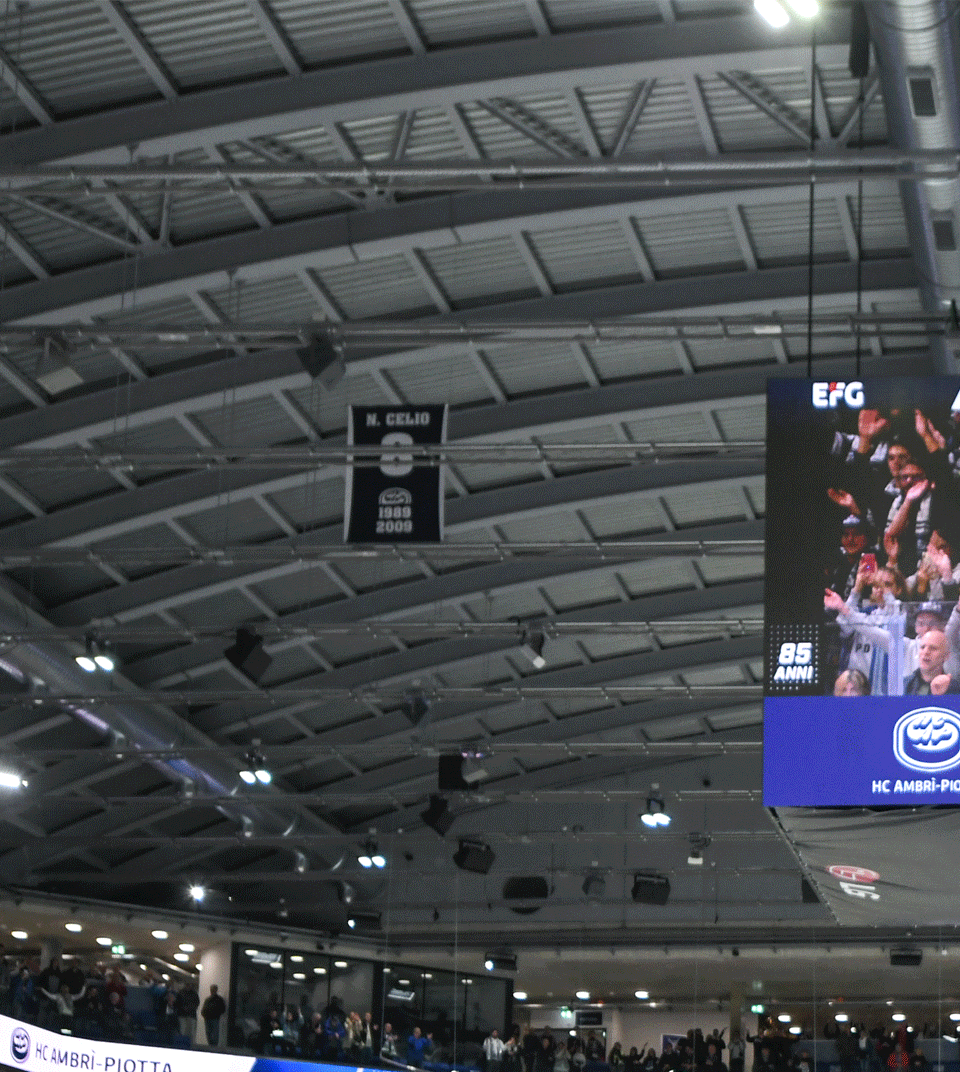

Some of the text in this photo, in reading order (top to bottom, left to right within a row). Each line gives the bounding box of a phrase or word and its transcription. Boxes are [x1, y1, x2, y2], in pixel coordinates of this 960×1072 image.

[812, 381, 864, 407] EFG
[366, 411, 430, 426] N. CELIO
[378, 506, 412, 519] 1989
[375, 519, 413, 533] 2009
[778, 642, 813, 665] 85
[773, 665, 814, 681] ANNI
[872, 780, 890, 793] HC
[35, 1042, 48, 1061] HC
